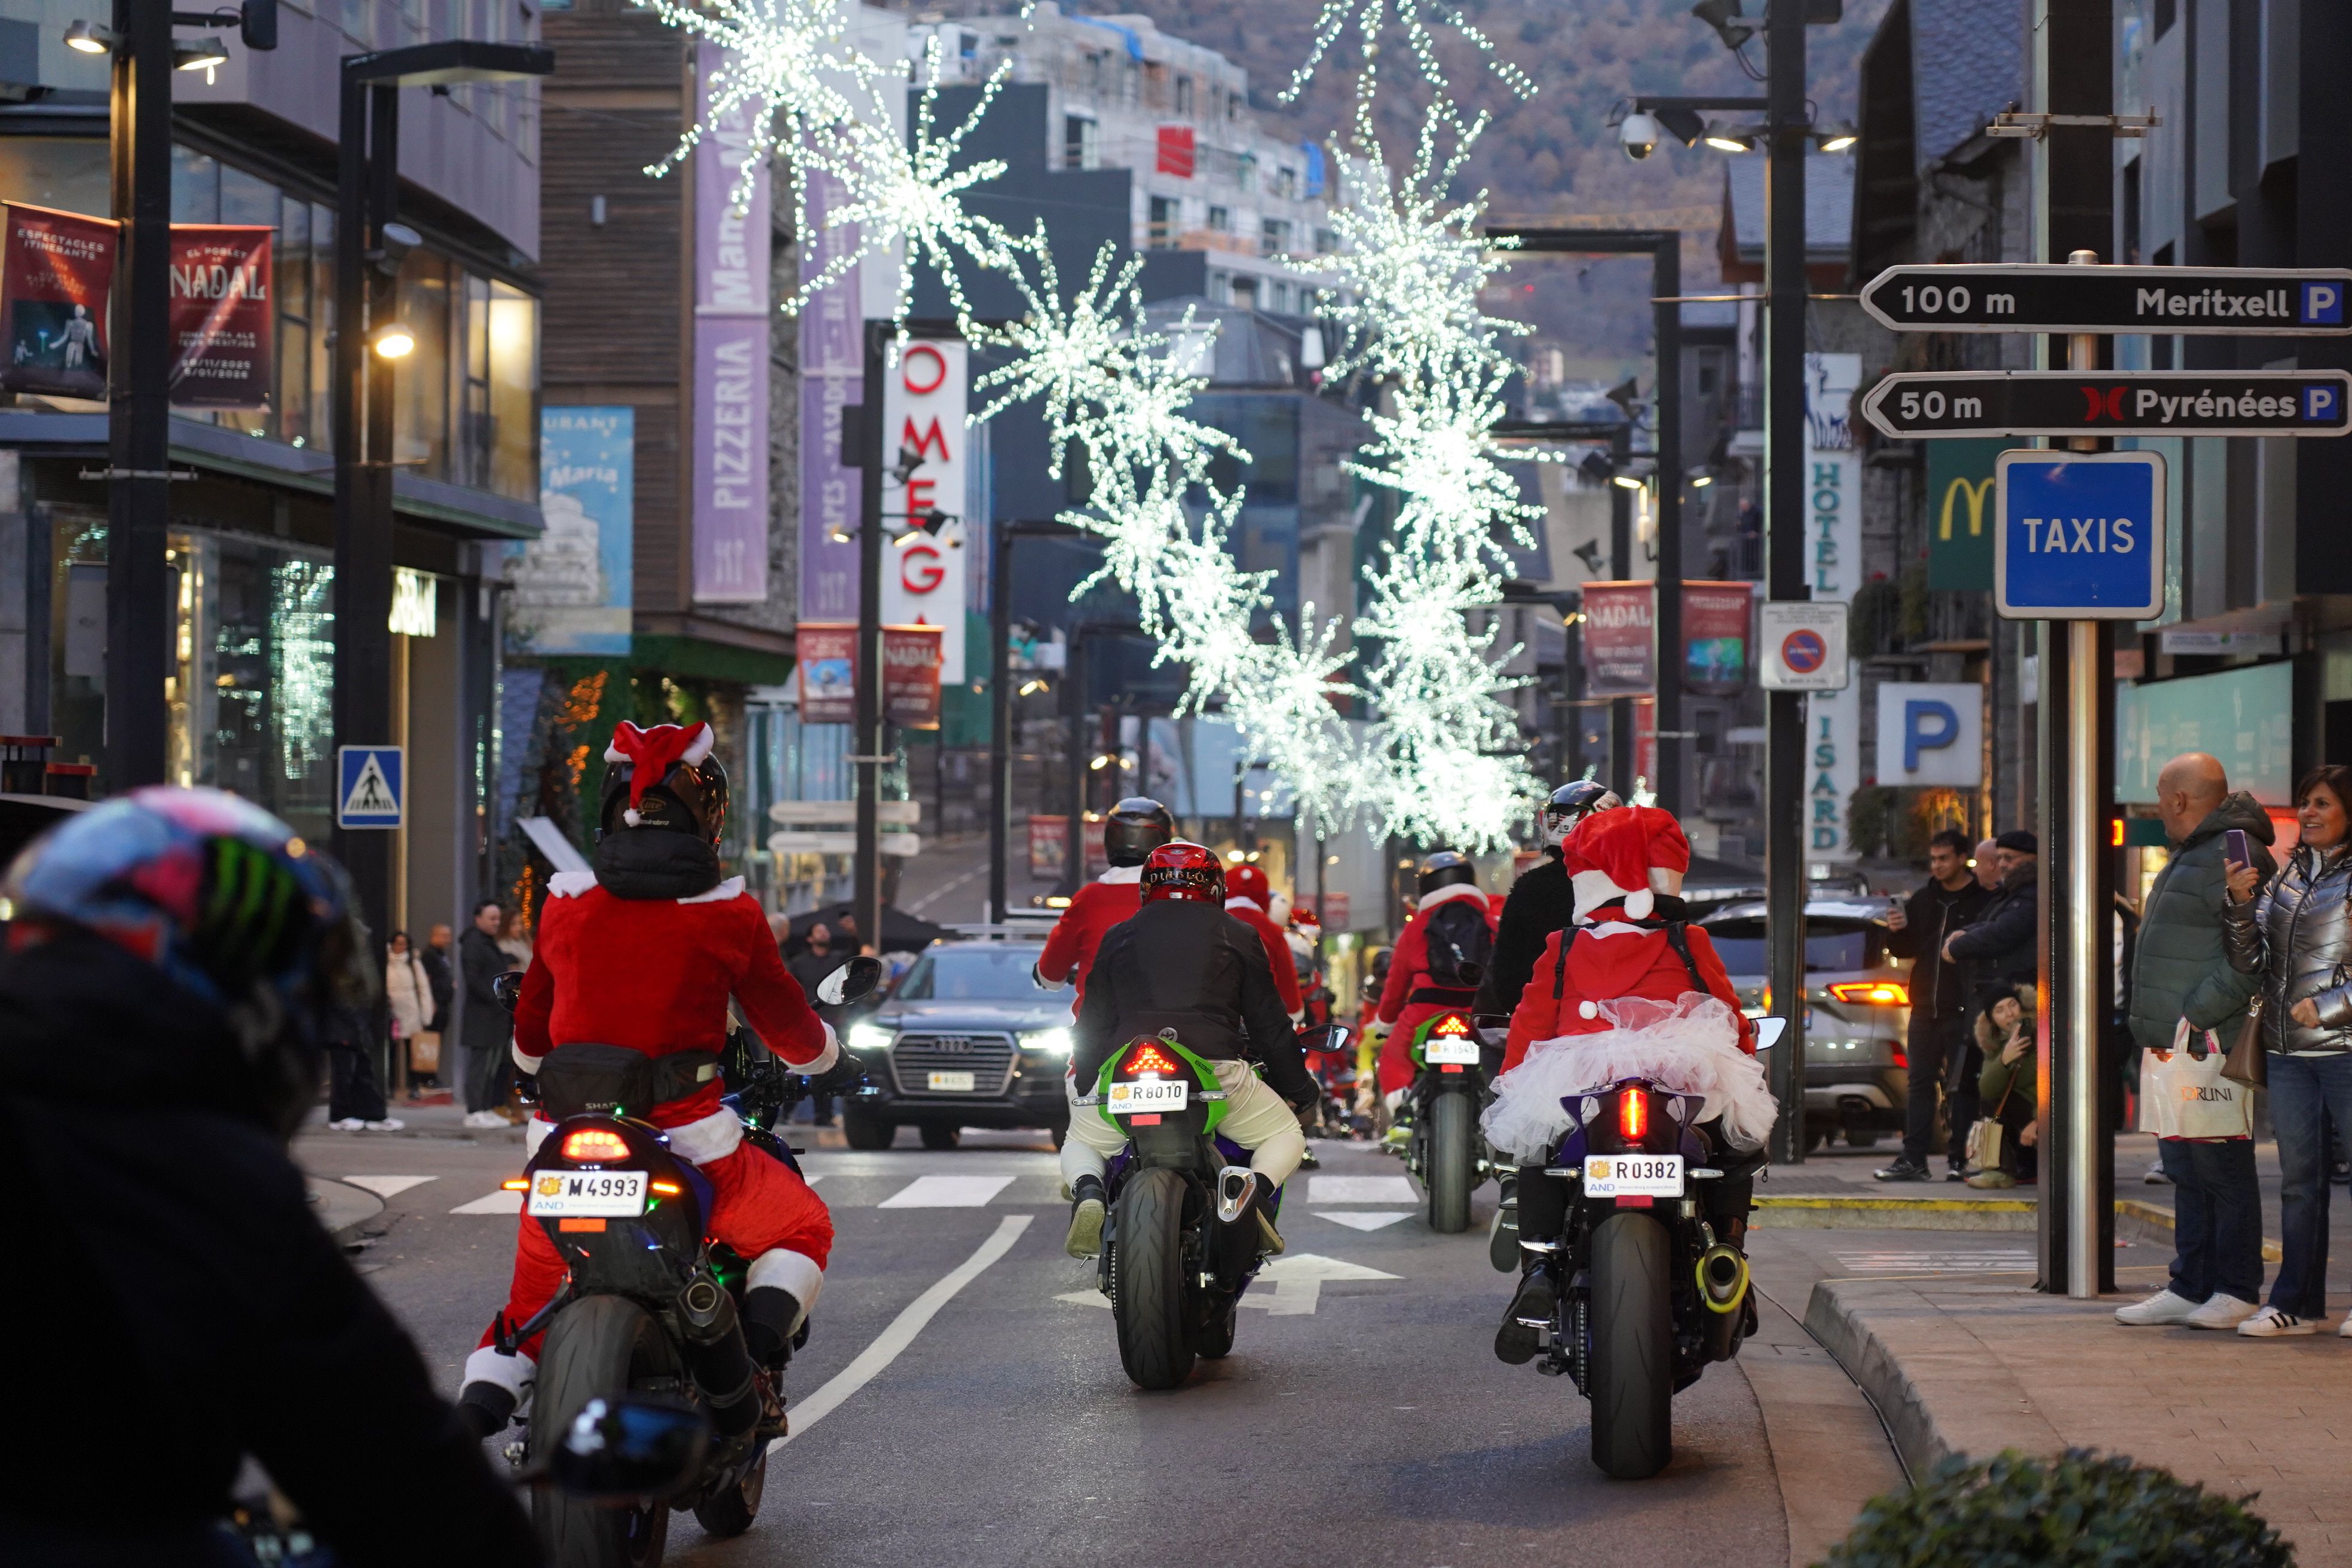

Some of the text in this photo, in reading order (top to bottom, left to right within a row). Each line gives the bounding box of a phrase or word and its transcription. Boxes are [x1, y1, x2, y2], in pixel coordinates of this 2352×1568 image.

[17, 228, 105, 253] ESPECTACLES
[24, 239, 96, 261] ITINERANTS
[204, 247, 247, 259] POBLET
[170, 264, 266, 300] NADAL
[1902, 285, 2336, 319] 100 m Meritxell P
[1900, 388, 2332, 424] 50 m Pyrénées P
[543, 416, 617, 431] URANT
[713, 339, 752, 510] PIZZERIA
[550, 465, 618, 488] Maria
[903, 345, 950, 624] OMEG
[1813, 463, 1841, 592] HOTEL
[2023, 517, 2136, 554] TAXIS
[1587, 604, 1652, 629] NADAL
[1904, 699, 1960, 772] P
[1150, 870, 1205, 884] DIABLO
[1133, 1085, 1181, 1100] R8010
[2180, 1086, 2233, 1101] DRUNI
[1616, 1161, 1676, 1179] R0382
[568, 1178, 639, 1197] M4993
[1589, 1183, 1615, 1192] AND
[534, 1200, 564, 1210] AND
